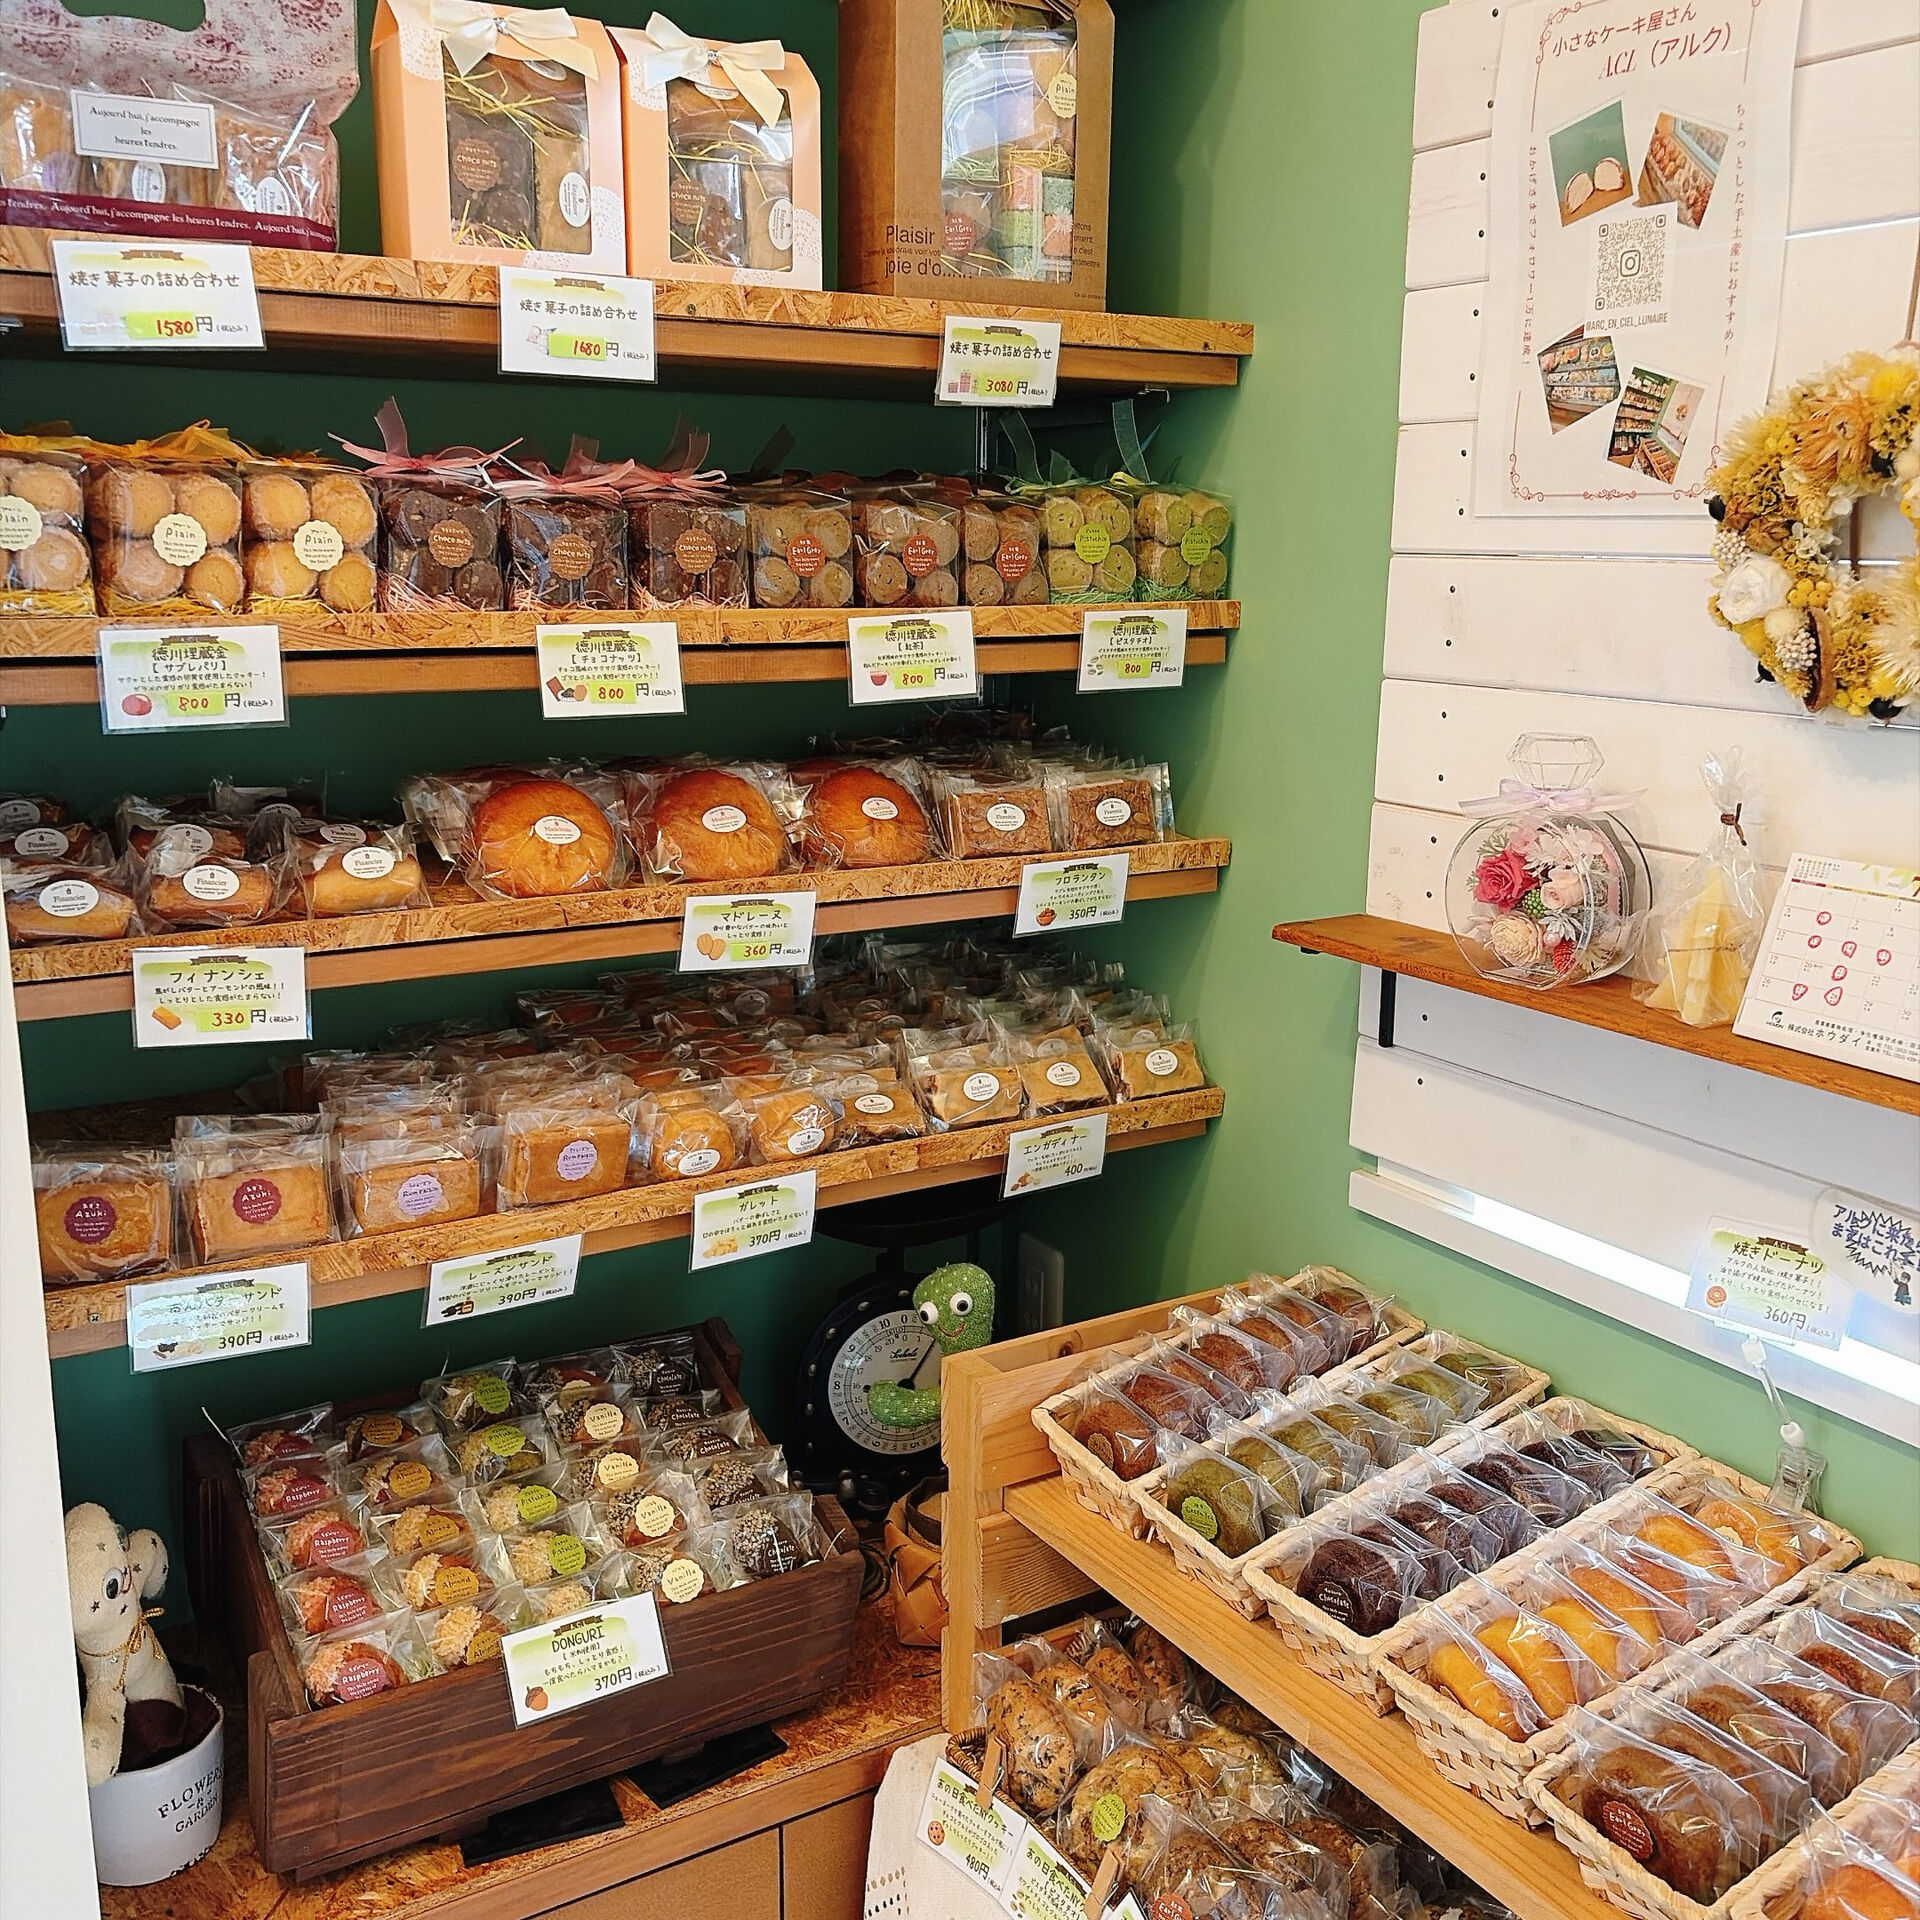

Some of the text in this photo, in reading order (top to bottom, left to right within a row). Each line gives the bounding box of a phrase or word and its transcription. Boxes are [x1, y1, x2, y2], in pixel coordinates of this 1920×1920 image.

[1552, 2, 1697, 57] 小さなケーキ屋さん
[1650, 21, 1732, 68] （アルク）
[140, 127, 152, 137] les
[171, 214, 185, 224] les
[885, 224, 936, 244] Plaisir
[884, 258, 916, 280] joie
[69, 271, 240, 290] 焼き菓子の詰め合わせ
[519, 299, 639, 322] 焼き菓子の詰め合わせ
[949, 342, 1054, 363] 焼き菓子の詰め合わせ
[165, 527, 197, 539] Plain
[305, 534, 333, 546] Plain
[884, 628, 937, 643] 徳川埋蔵金
[1112, 624, 1160, 636] 徳川埋蔵金
[151, 645, 230, 663] 徳川埋蔵金
[575, 639, 639, 655] 徳川埋蔵金
[1055, 871, 1106, 886] フロランタン
[720, 909, 782, 924] マドレーヌ
[1068, 906, 1098, 921] 350円
[169, 968, 266, 985] フィナンシェ
[1023, 1134, 1088, 1155] エンガディナー
[241, 1190, 272, 1203] Azuki
[739, 1196, 779, 1213] ガレット
[75, 1209, 107, 1219] Azuki
[749, 1229, 782, 1249] 370円
[1732, 1240, 1825, 1275] 焼きドーナツ
[468, 1254, 553, 1283] レーズンサンド
[498, 1288, 537, 1307] 390円
[878, 1318, 891, 1329] 10
[901, 1314, 908, 1325] 0
[1763, 1305, 1808, 1331] 360円
[218, 1330, 262, 1351] 390円
[847, 1344, 856, 1353] 9
[833, 1380, 841, 1390] 8
[589, 1409, 618, 1424] Vanilla
[699, 1439, 732, 1455] Chocolate
[604, 1461, 634, 1472] Vanilla
[285, 1489, 321, 1503] Raspberry
[640, 1504, 668, 1520] Vanilla
[314, 1537, 351, 1551] Raspberry
[666, 1568, 697, 1586] Vanilla
[332, 1595, 366, 1614] Raspberry
[1318, 1592, 1350, 1610] Chocolate
[551, 1625, 606, 1654] DONGURI
[341, 1667, 380, 1686] Raspberry
[593, 1666, 633, 1692] 370円
[1609, 1811, 1628, 1828] Earl
[965, 1853, 991, 1882] 480円
